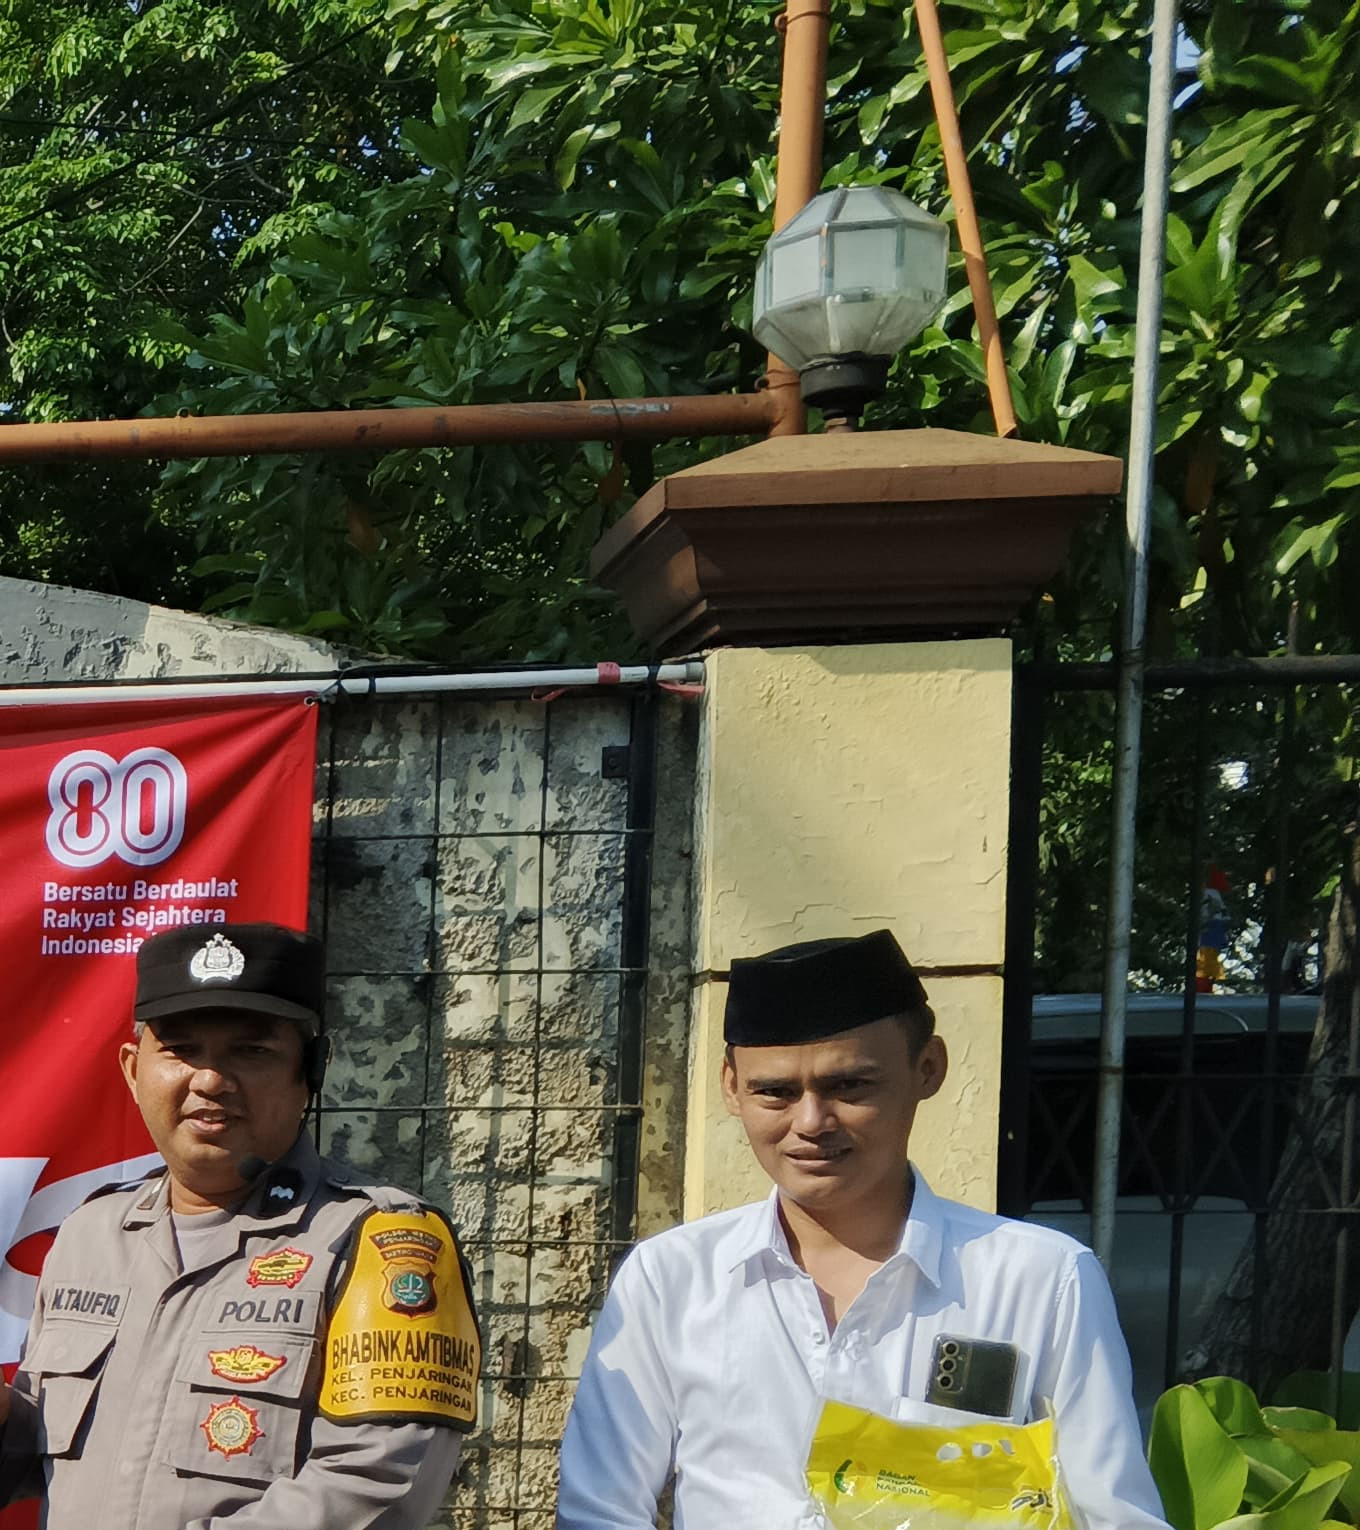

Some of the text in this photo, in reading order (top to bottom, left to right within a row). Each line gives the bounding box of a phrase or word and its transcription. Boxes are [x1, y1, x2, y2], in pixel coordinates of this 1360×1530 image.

[45, 747, 187, 868] 80
[44, 877, 238, 902] Bersatu Berdaulat
[43, 904, 226, 932] Rakyat Sejahtera
[218, 1299, 304, 1324] POLRI
[331, 1371, 363, 1386] KEL.
[331, 1389, 365, 1405] KEC.
